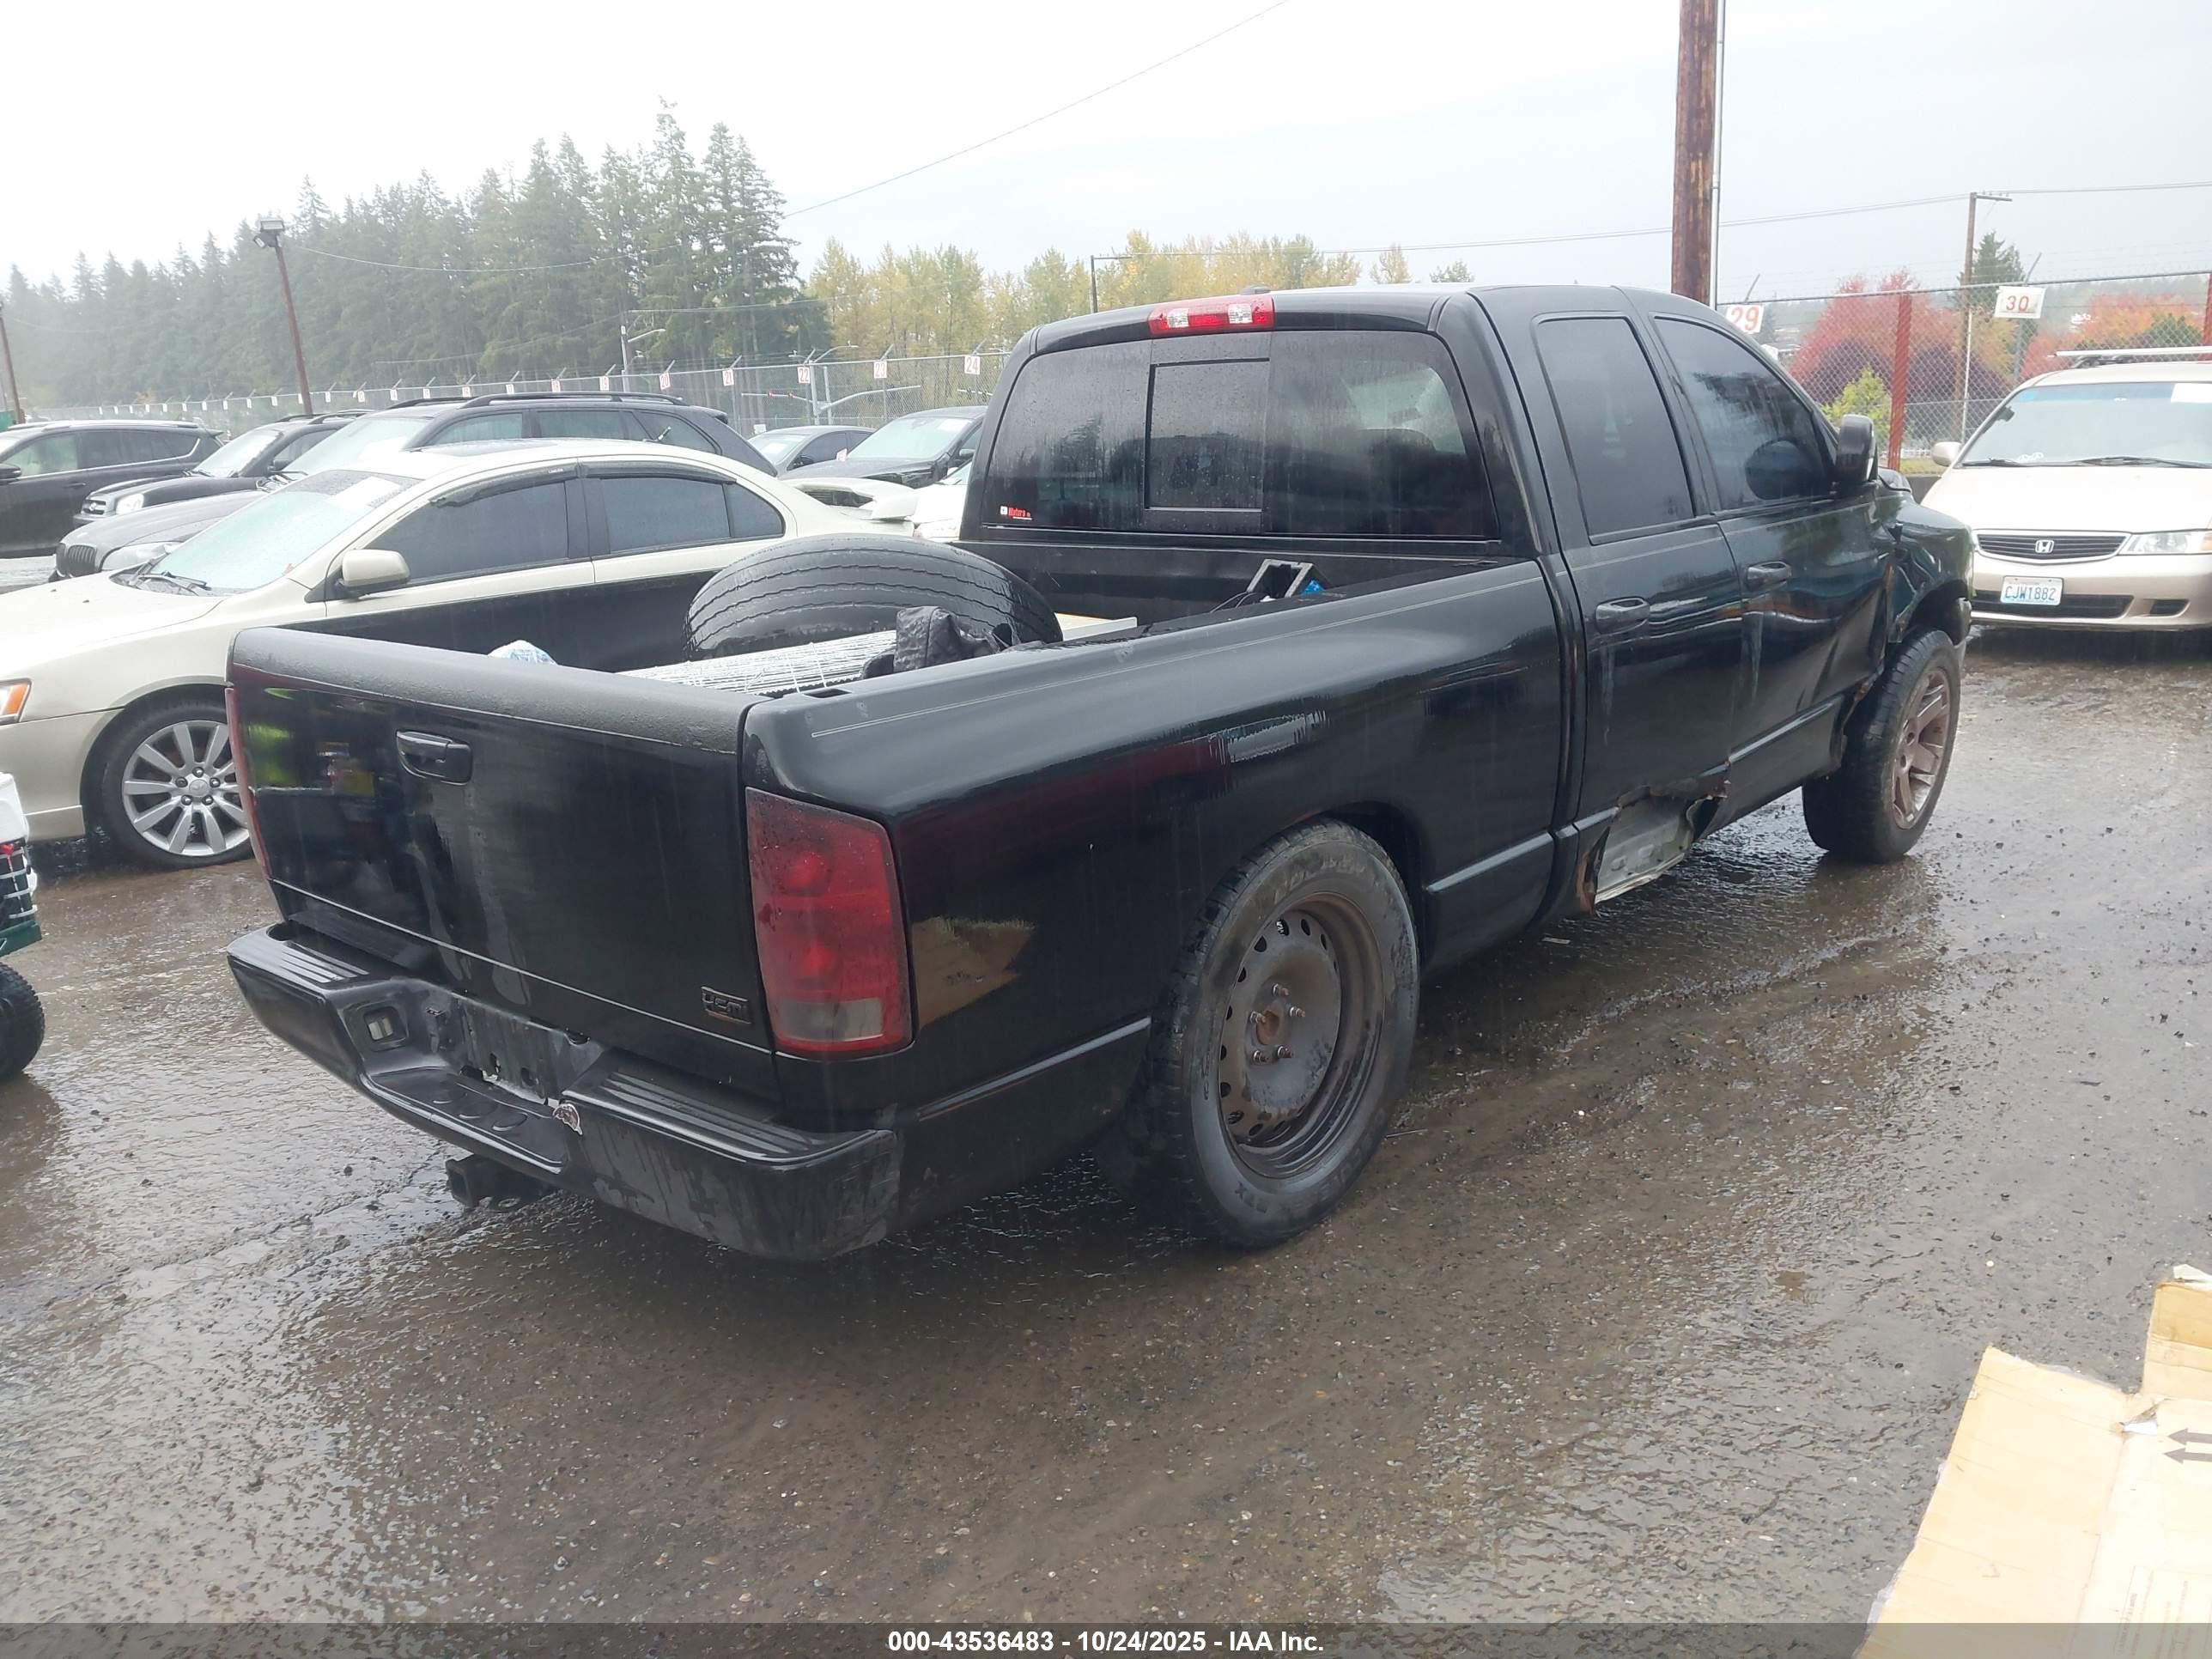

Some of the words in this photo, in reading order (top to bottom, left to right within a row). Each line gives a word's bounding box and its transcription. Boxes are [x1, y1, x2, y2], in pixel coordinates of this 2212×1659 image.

[2005, 295, 2030, 312] 30
[1730, 306, 1759, 331] 29
[875, 362, 886, 377] 23
[966, 357, 979, 373] 24
[660, 373, 670, 388] 20
[724, 368, 733, 384] 21
[799, 368, 810, 382] 22
[2005, 585, 2057, 601] CJW1882
